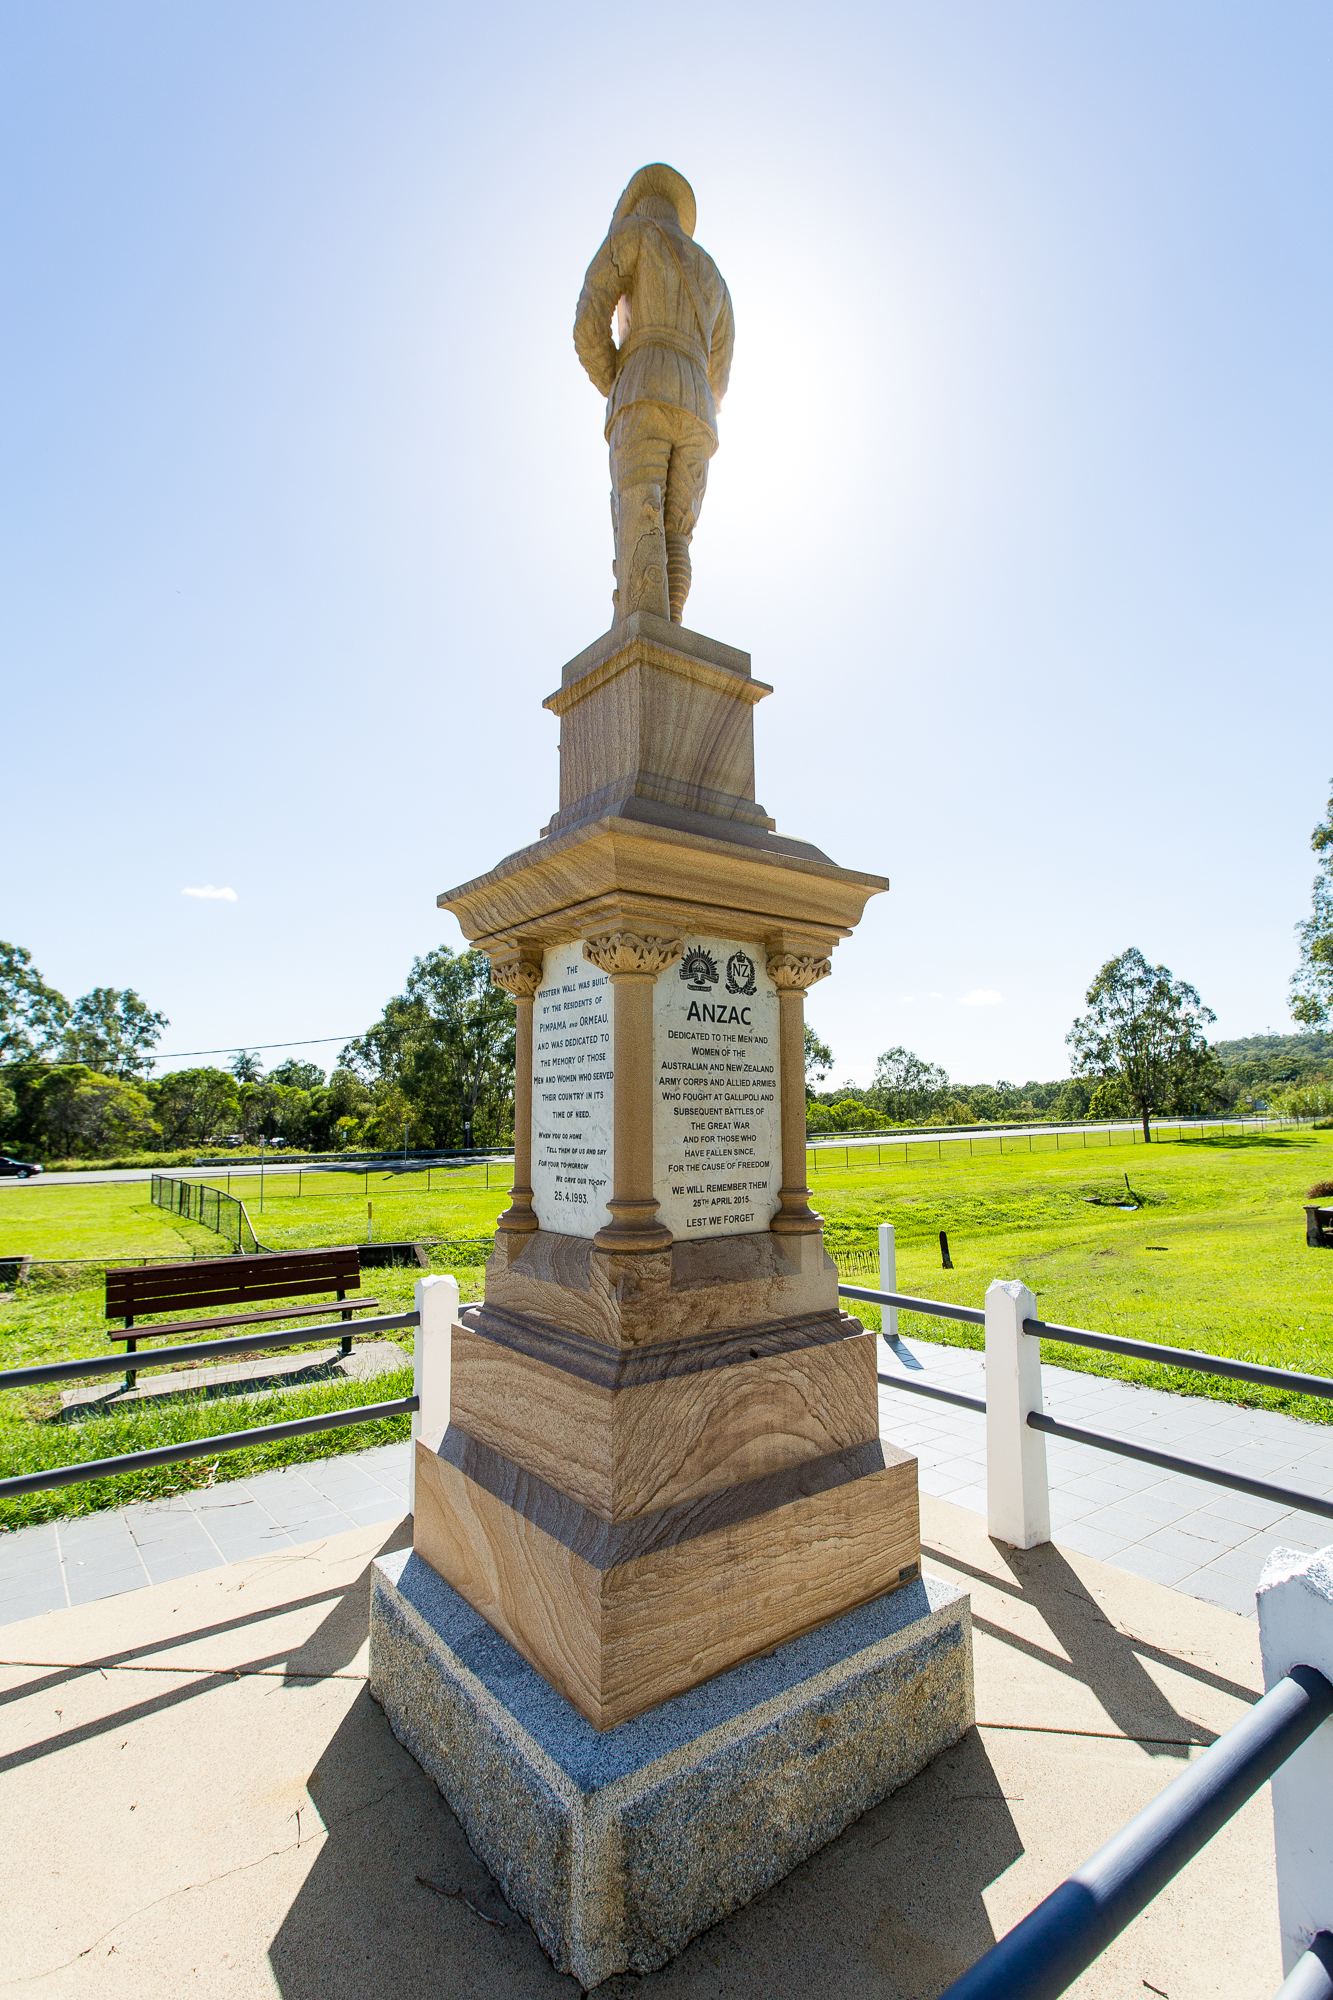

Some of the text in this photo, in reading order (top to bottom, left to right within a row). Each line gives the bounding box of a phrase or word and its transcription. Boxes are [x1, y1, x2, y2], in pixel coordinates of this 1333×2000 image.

[567, 966, 578, 975] THE
[733, 963, 749, 978] NZ
[538, 988, 560, 999] WESTERN
[578, 982, 590, 990] WAS
[592, 976, 608, 987] BUILT
[564, 999, 592, 1010] RESIDENTS
[595, 996, 602, 1004] OF
[687, 1001, 751, 1025] ANZAC
[540, 1020, 566, 1033] PIMPAMA
[580, 1014, 608, 1027] ORMEAU,
[538, 1034, 609, 1050] AND WAS DEDICATED TO
[668, 1030, 709, 1040] DEDICATED
[755, 1036, 768, 1044] AND
[692, 1047, 719, 1056] WOMEN
[552, 1057, 575, 1066] MEMORY
[578, 1055, 584, 1063] OF
[587, 1053, 606, 1062] THOSE
[662, 1061, 708, 1070] AUSTRALIAN
[726, 1063, 742, 1071] NEW
[744, 1064, 774, 1072] ZEALAND
[534, 1077, 543, 1085] MEN
[557, 1074, 576, 1083] WOMEN
[578, 1073, 591, 1081] WHO
[593, 1071, 614, 1081] SERVED
[659, 1077, 681, 1085] ARMY
[683, 1078, 708, 1086] CORPS
[559, 1092, 584, 1101] COUNTRY
[594, 1091, 603, 1099] ITS
[683, 1093, 712, 1101] FOUGHT
[725, 1093, 759, 1101] GALLIPOLI
[674, 1107, 722, 1116] SUBSEQUENT
[691, 1122, 705, 1130] THE
[734, 1148, 755, 1156] SINCE,
[560, 1162, 588, 1170] TO-MORROW
[738, 1161, 769, 1169] FREEDOM
[687, 1185, 704, 1193] WILL
[707, 1183, 747, 1192] REMEMBER
[749, 1181, 767, 1189] THEM
[554, 1191, 588, 1204] 25.4.1993.
[711, 1197, 732, 1206] APRIL
[734, 1196, 749, 1204] 2015
[687, 1213, 754, 1227] LEST WE FORGET
